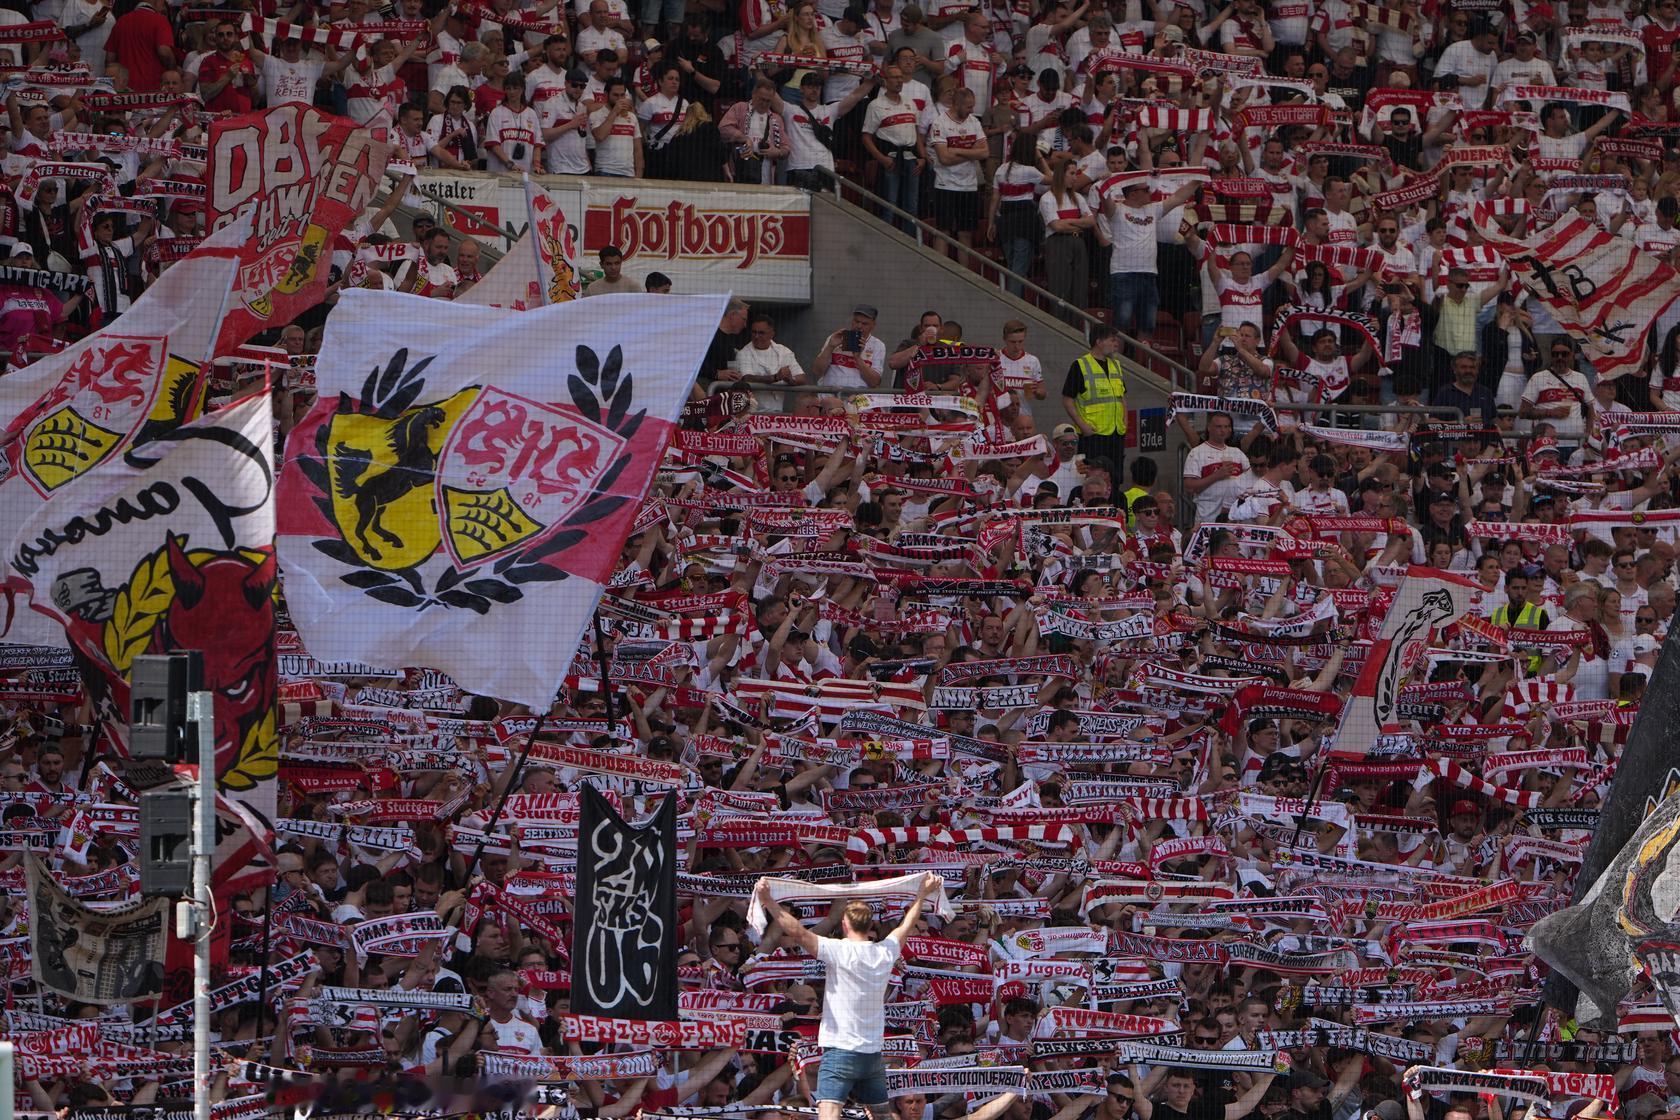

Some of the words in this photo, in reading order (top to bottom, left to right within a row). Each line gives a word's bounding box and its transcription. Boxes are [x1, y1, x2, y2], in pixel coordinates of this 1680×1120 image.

[373, 243, 406, 259] VfB
[965, 981, 1020, 998] Stuttart
[1052, 1010, 1165, 1033] STUTTGART
